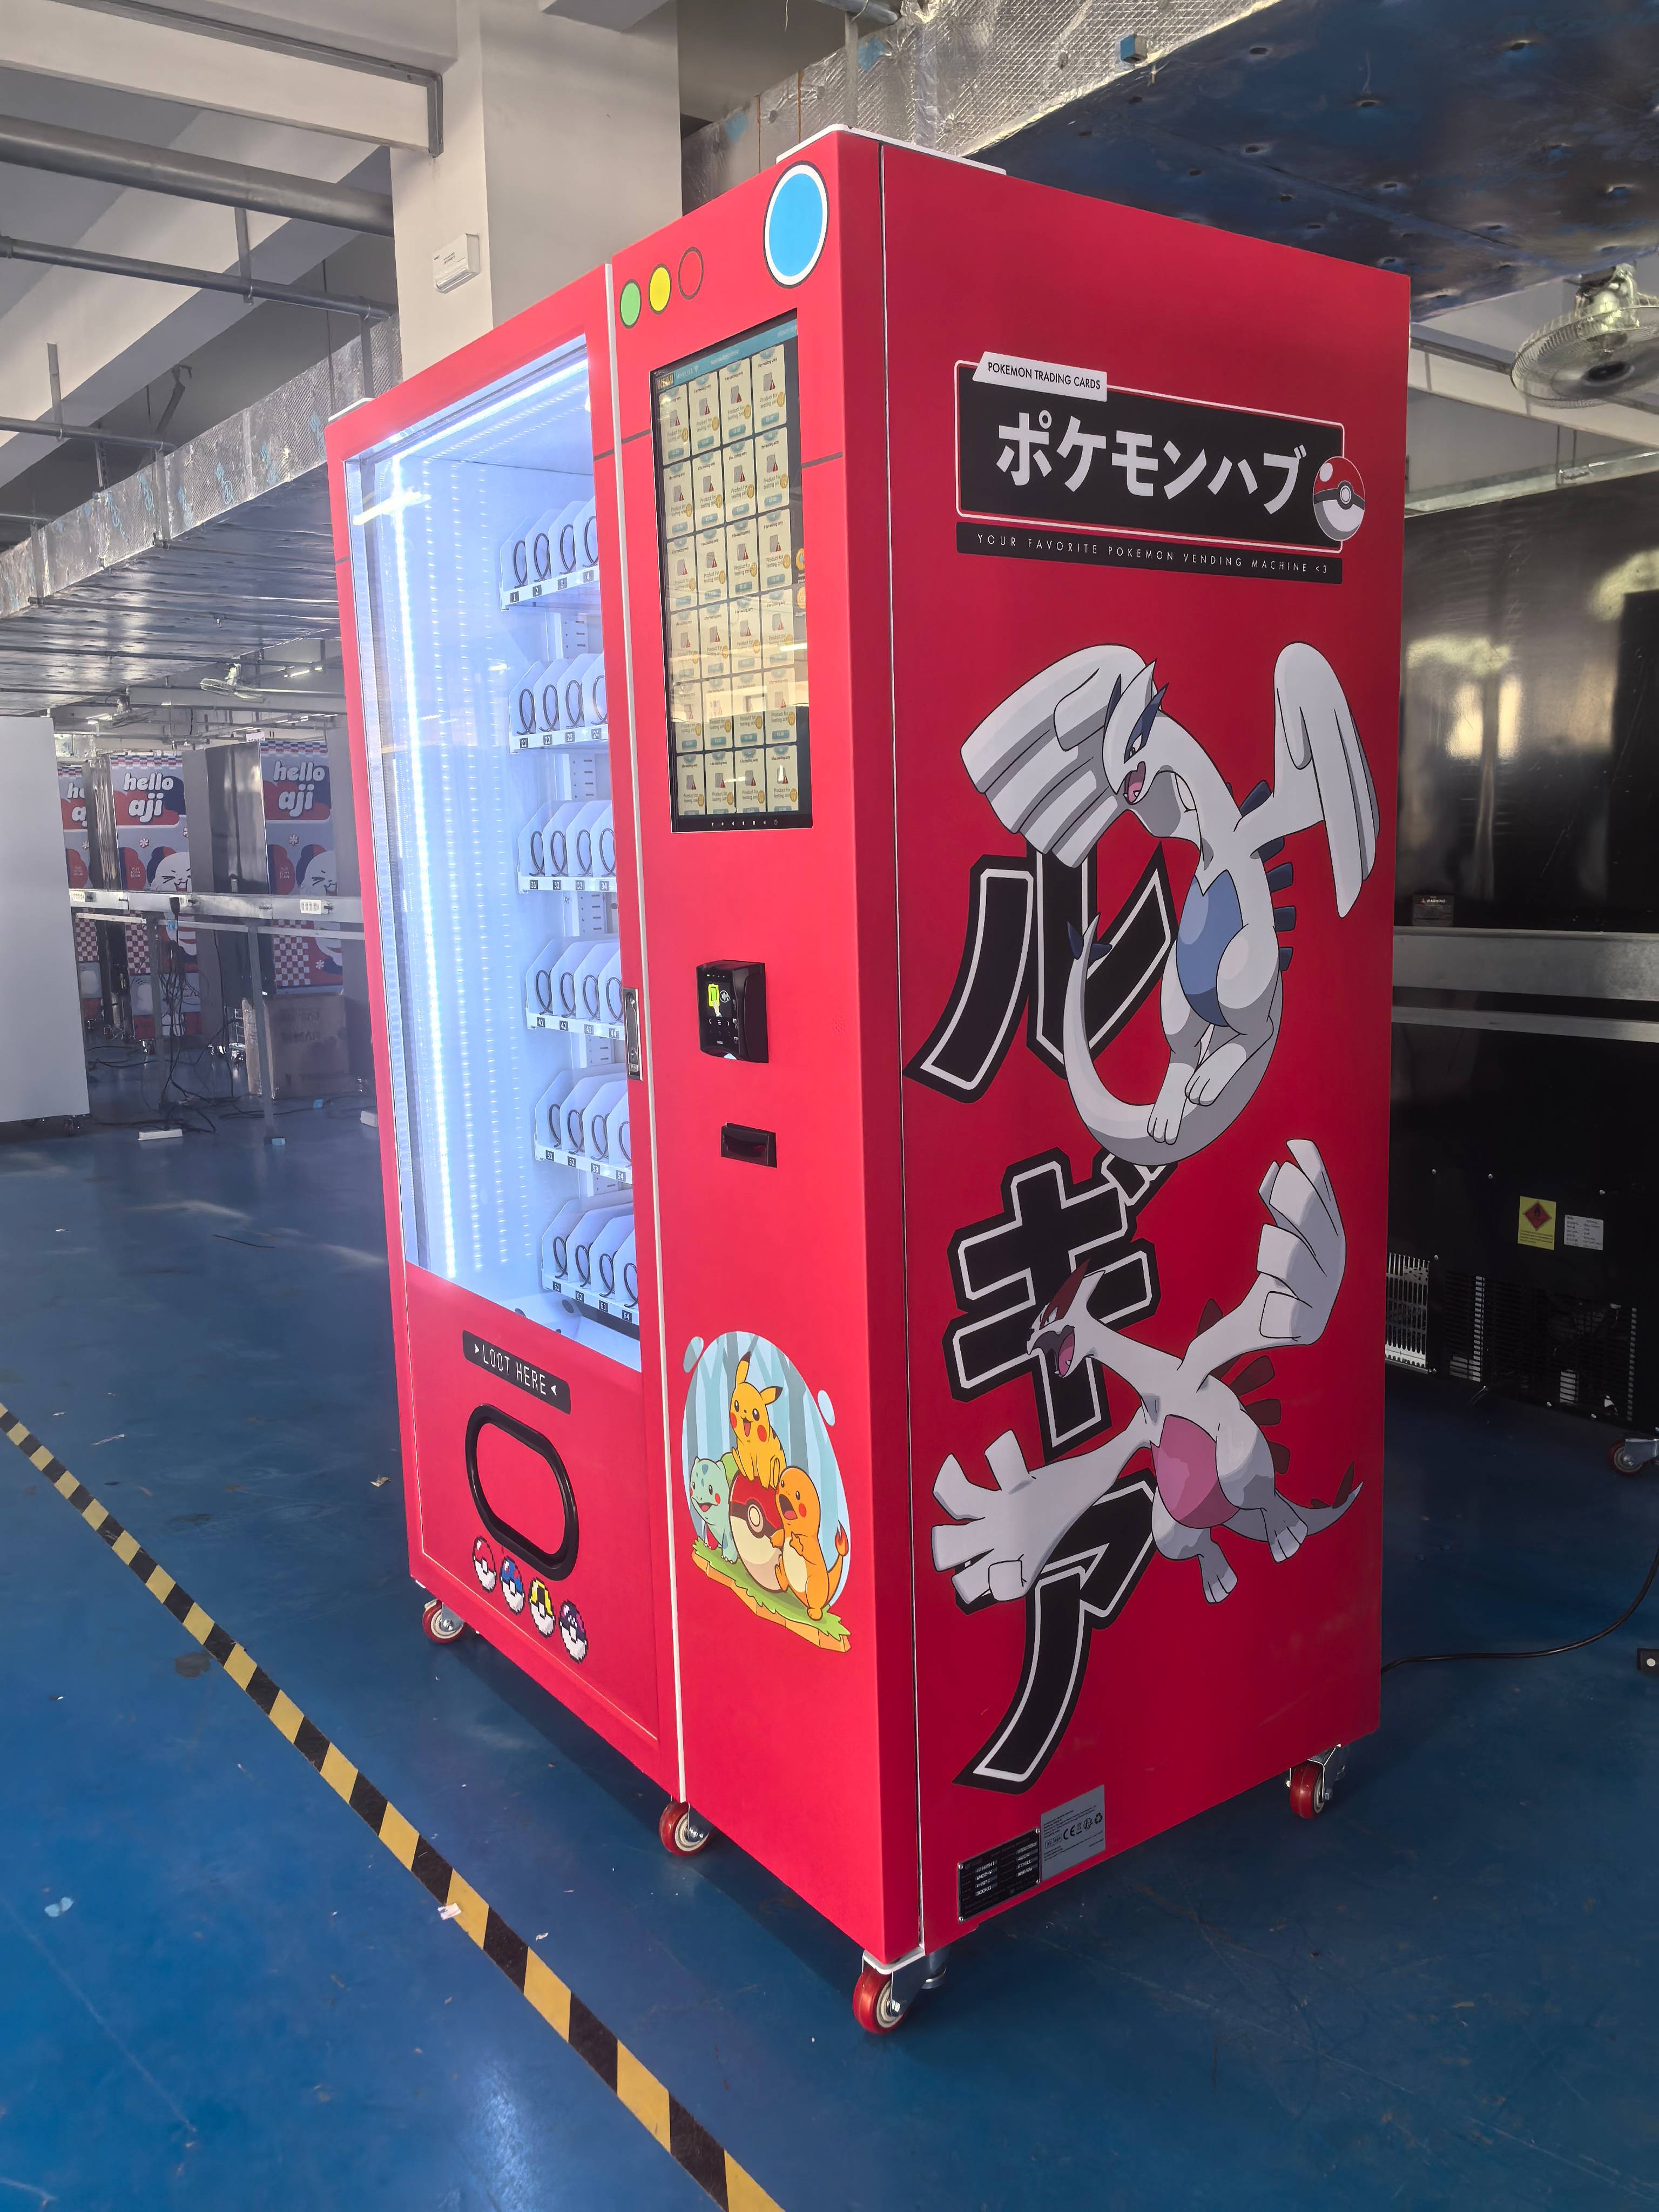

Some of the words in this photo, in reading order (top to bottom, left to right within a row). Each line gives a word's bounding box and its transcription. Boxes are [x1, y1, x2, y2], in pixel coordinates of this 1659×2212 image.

[988, 361, 1033, 380] POKEMON
[1034, 368, 1072, 385] TRADING
[1074, 375, 1101, 390] CARDS
[995, 410, 1306, 515] ポケモンハブ
[977, 533, 1016, 548] YOUR
[1028, 538, 1098, 555] FAVORITE
[1108, 545, 1174, 562] POKEMON
[1183, 552, 1243, 567] VENDING
[1252, 559, 1307, 572] MACHINE
[123, 772, 174, 792] hello
[273, 760, 325, 781] hello
[127, 793, 164, 823] aji
[278, 784, 315, 817] aji
[482, 1344, 510, 1375] LOOT
[516, 1361, 547, 1395] HERE
